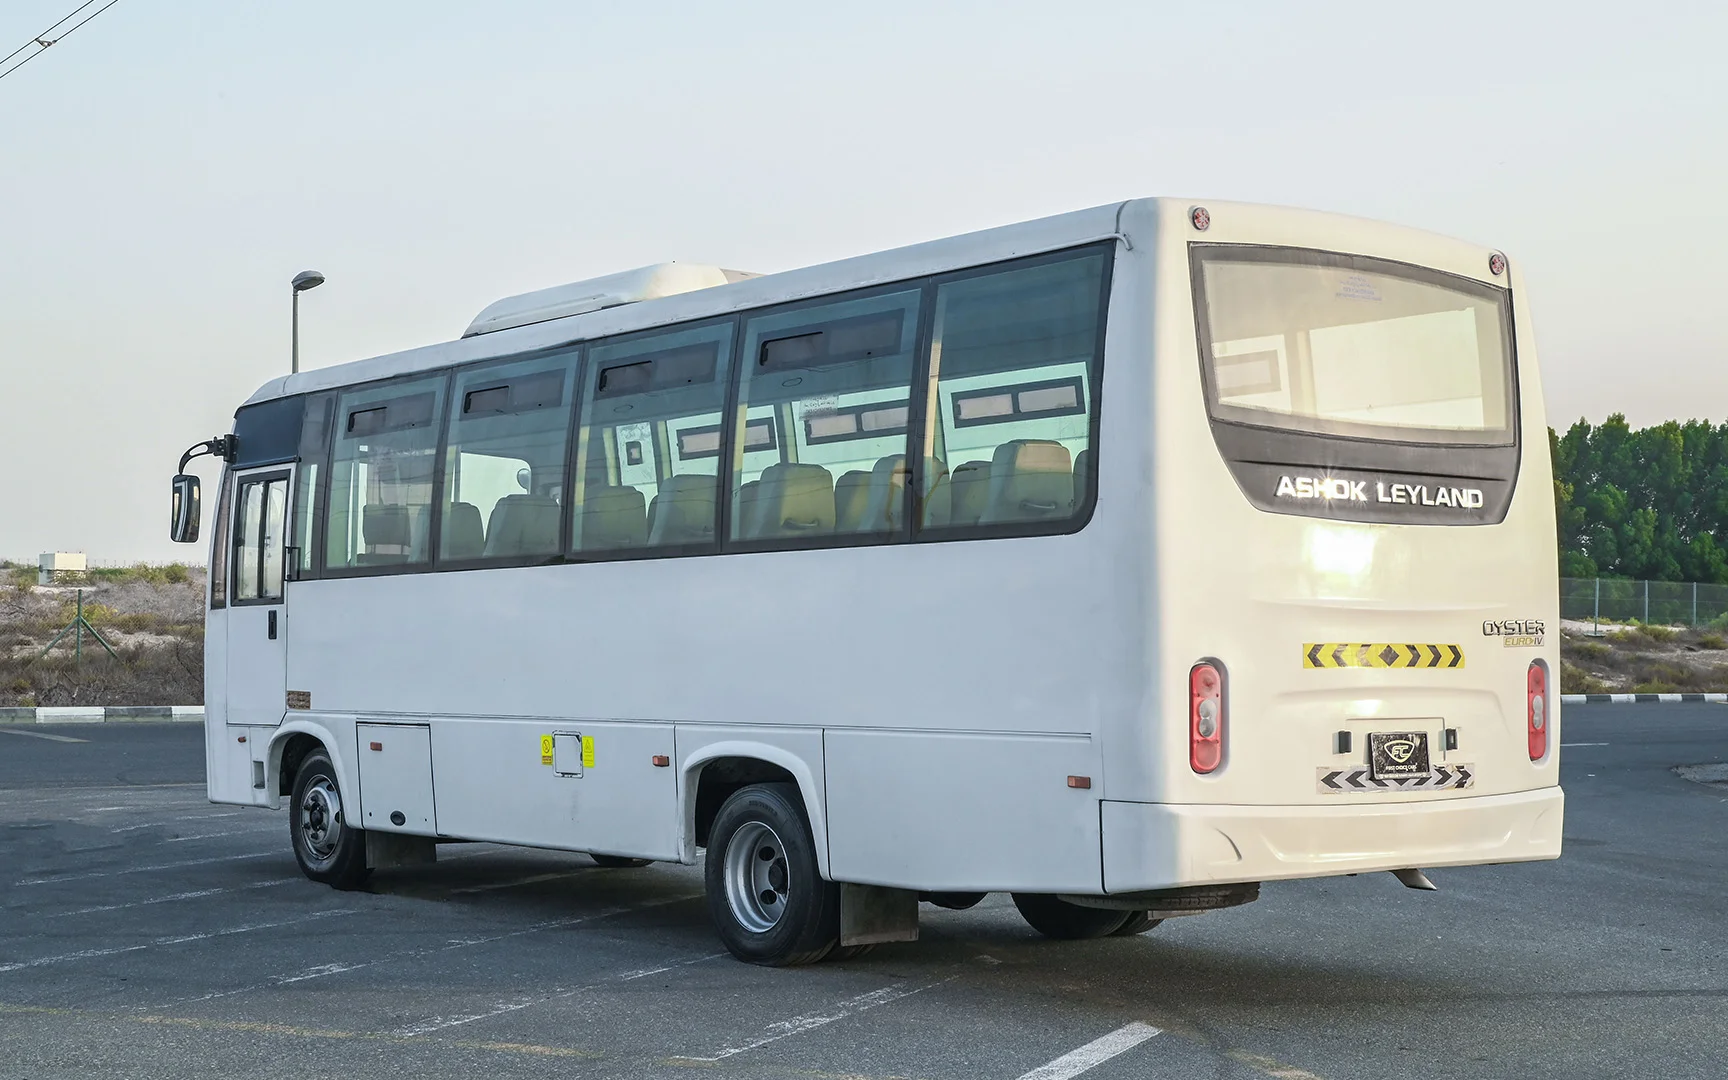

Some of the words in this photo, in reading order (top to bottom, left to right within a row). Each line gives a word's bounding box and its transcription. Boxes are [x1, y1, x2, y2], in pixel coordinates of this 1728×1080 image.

[1276, 475, 1368, 502] ASHOK
[1376, 482, 1484, 508] LEYLAND
[1482, 620, 1545, 636] OYSTER
